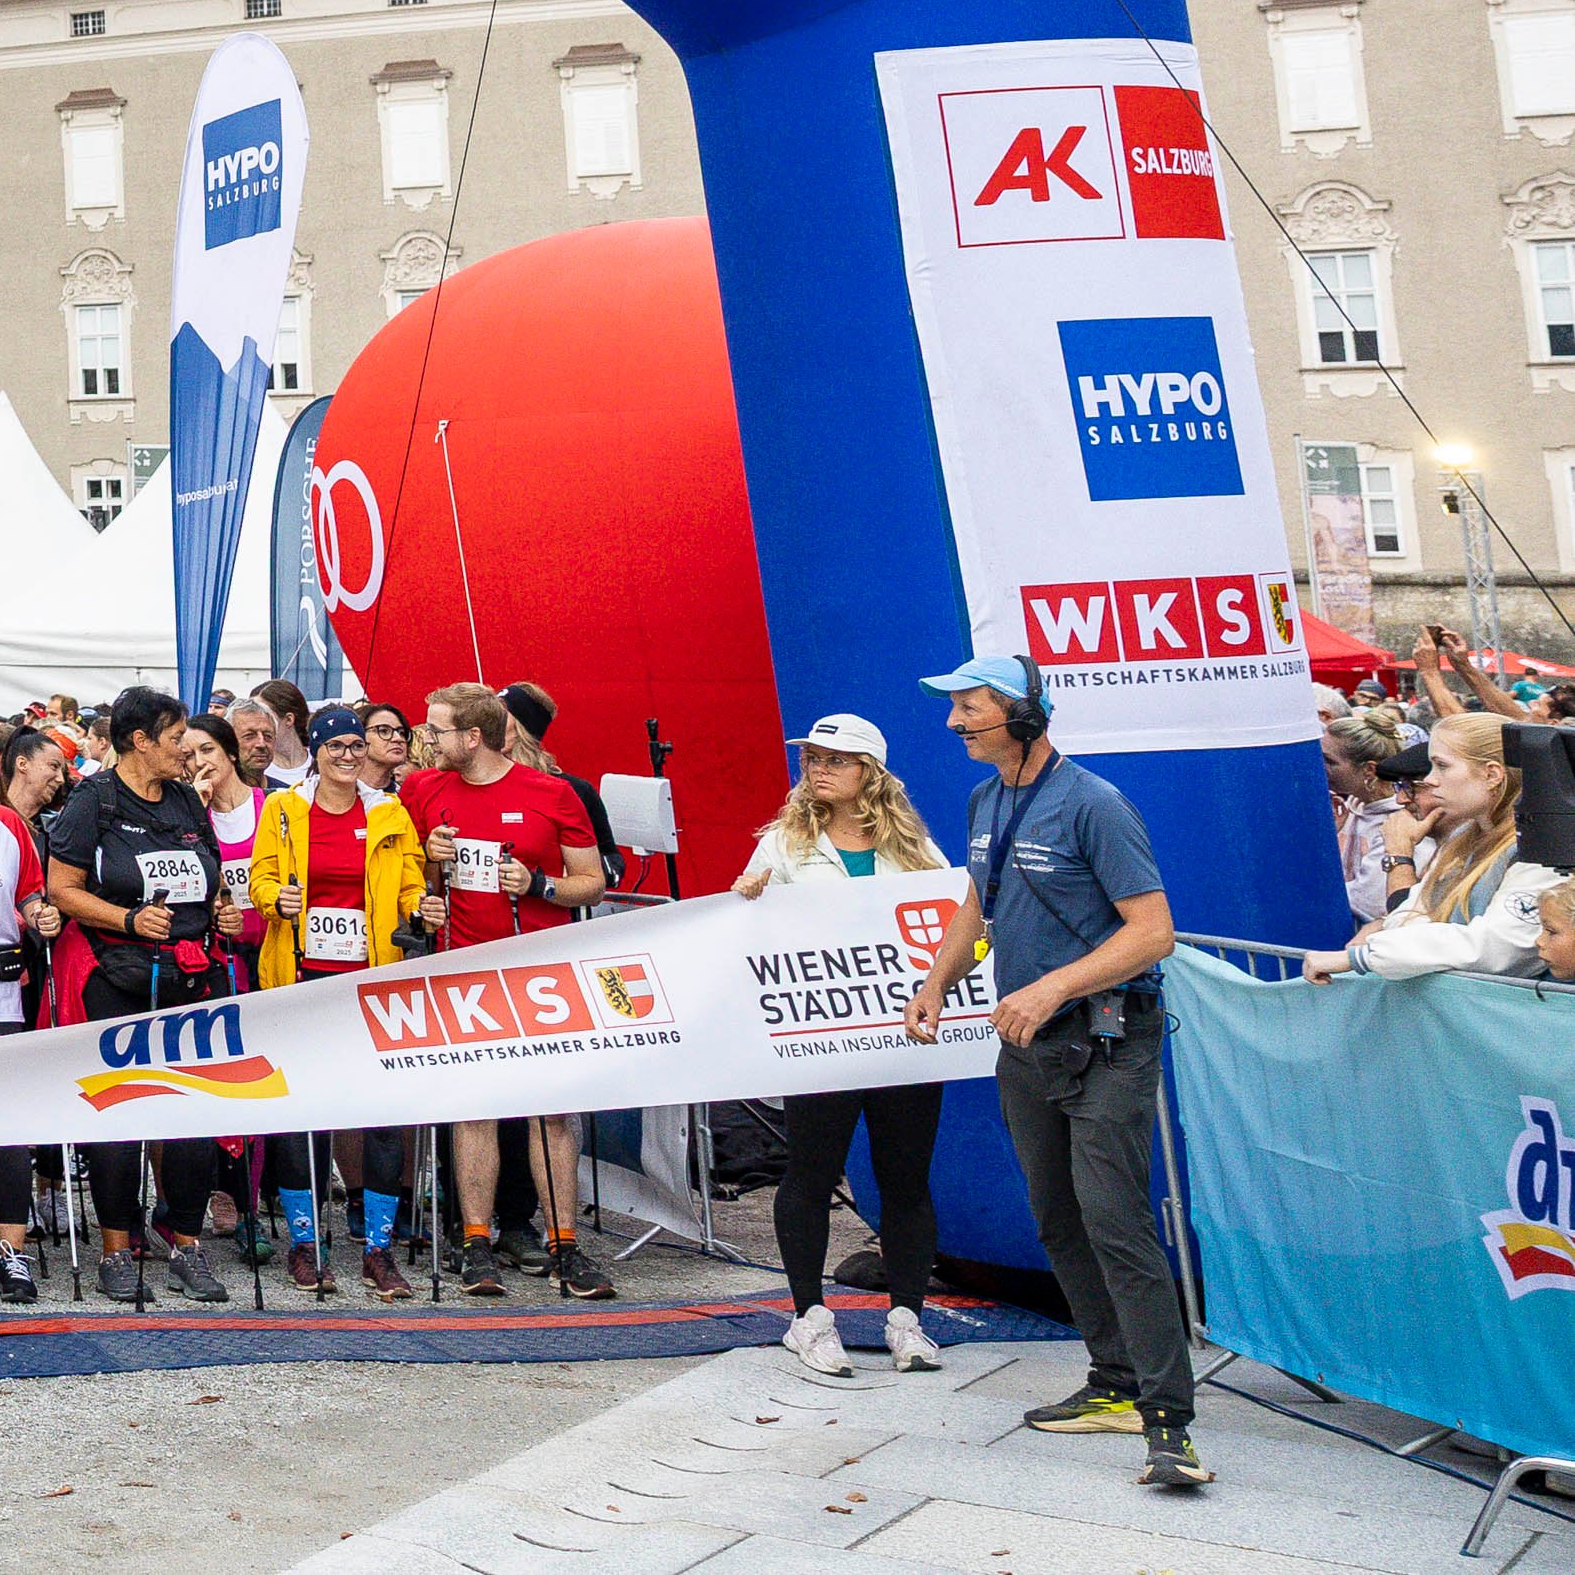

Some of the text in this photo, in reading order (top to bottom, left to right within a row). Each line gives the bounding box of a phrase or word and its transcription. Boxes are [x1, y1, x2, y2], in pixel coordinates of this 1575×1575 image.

[207, 141, 280, 192] HYPO
[974, 125, 1213, 207] AK SALZBURG
[208, 176, 280, 211] SALZBURG
[1078, 371, 1222, 419] HYPO
[1088, 421, 1229, 446] SALZBURG
[1029, 587, 1251, 655] WKS
[746, 943, 905, 986] WIENER
[364, 975, 571, 1042] WKS
[760, 974, 990, 1025] STÄDTISHE
[380, 1030, 682, 1071] WIRTSCHAFTSKAMMER SALZBURG
[773, 1040, 839, 1059] VIENNA
[942, 1025, 996, 1045] GROUP
